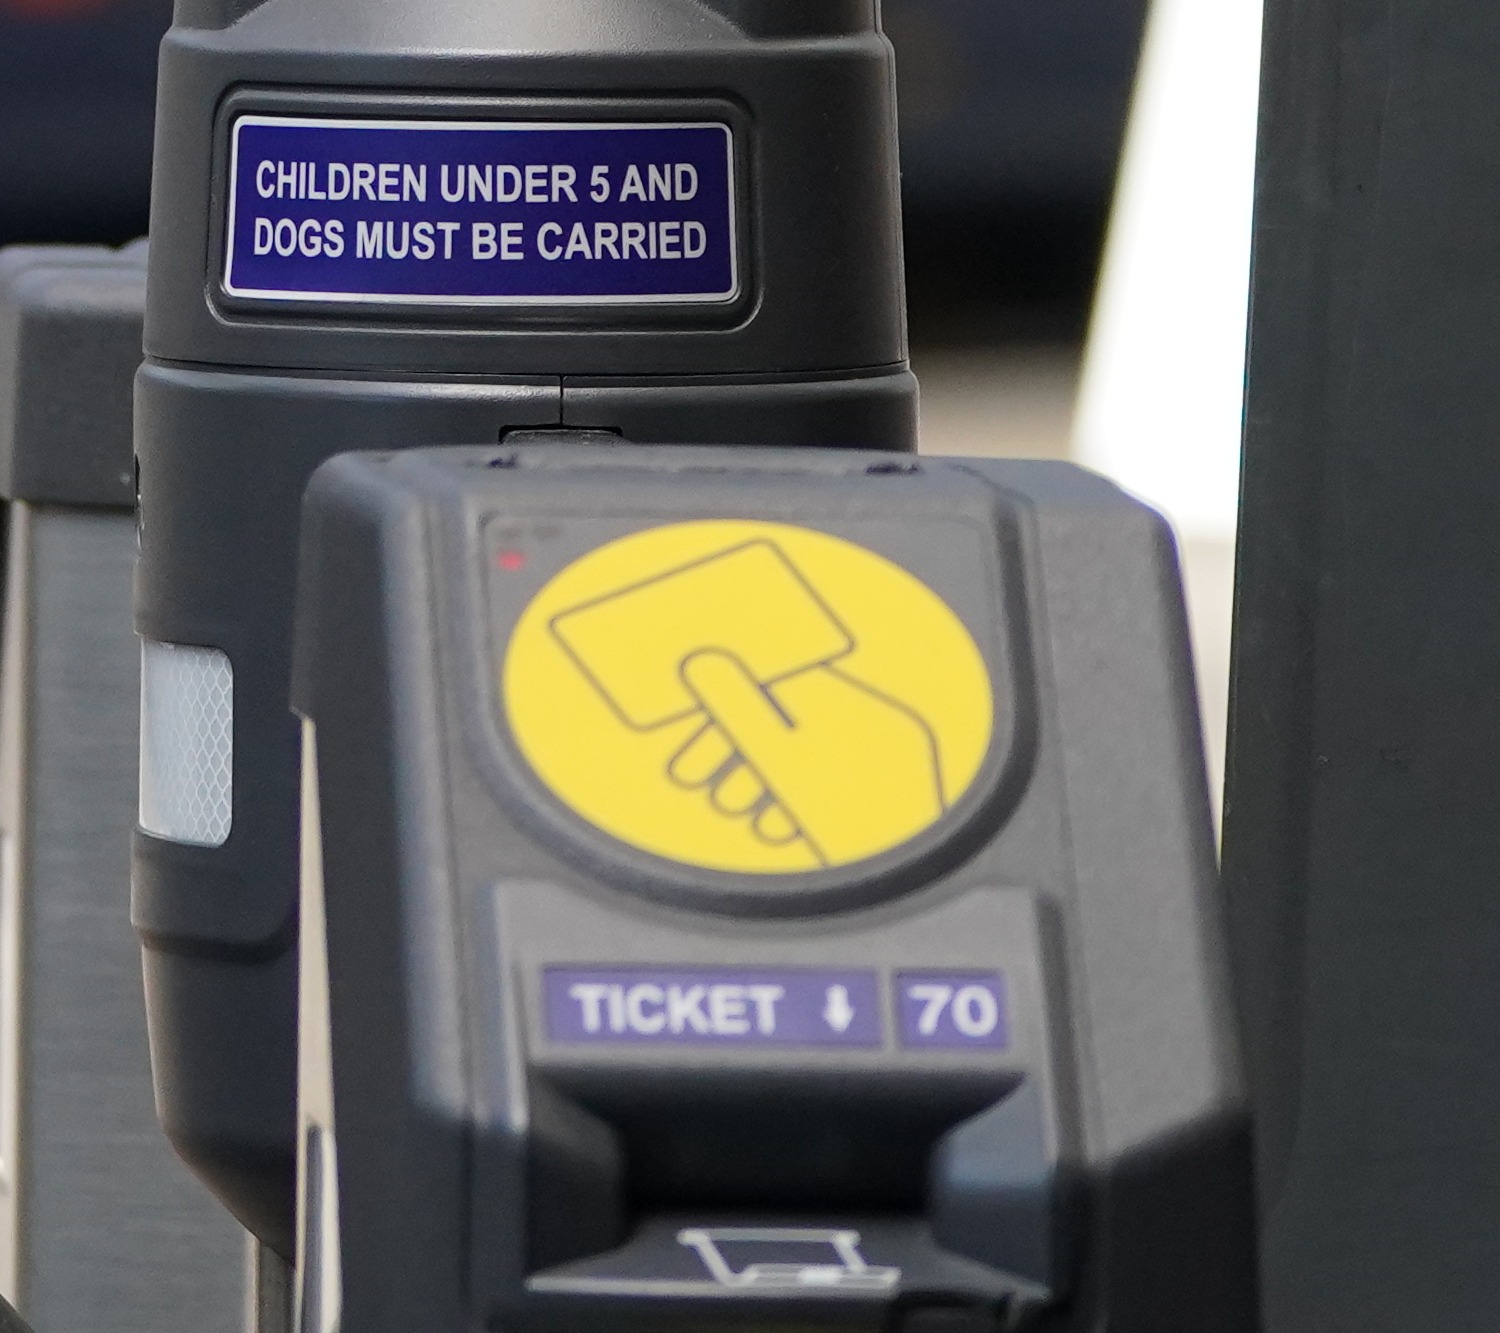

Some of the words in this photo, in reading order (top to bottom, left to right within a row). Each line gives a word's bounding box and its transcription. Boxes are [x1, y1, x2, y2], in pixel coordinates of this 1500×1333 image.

[255, 159, 427, 202] CHILDREN
[440, 164, 579, 203] UNDER
[590, 165, 610, 203] 5
[619, 163, 699, 202] AND
[253, 217, 345, 258] DOGS
[355, 220, 461, 260] MUST
[471, 222, 525, 261] BE
[536, 221, 707, 261] CARRIED
[567, 982, 786, 1036] TICKET
[907, 984, 999, 1037] 70
